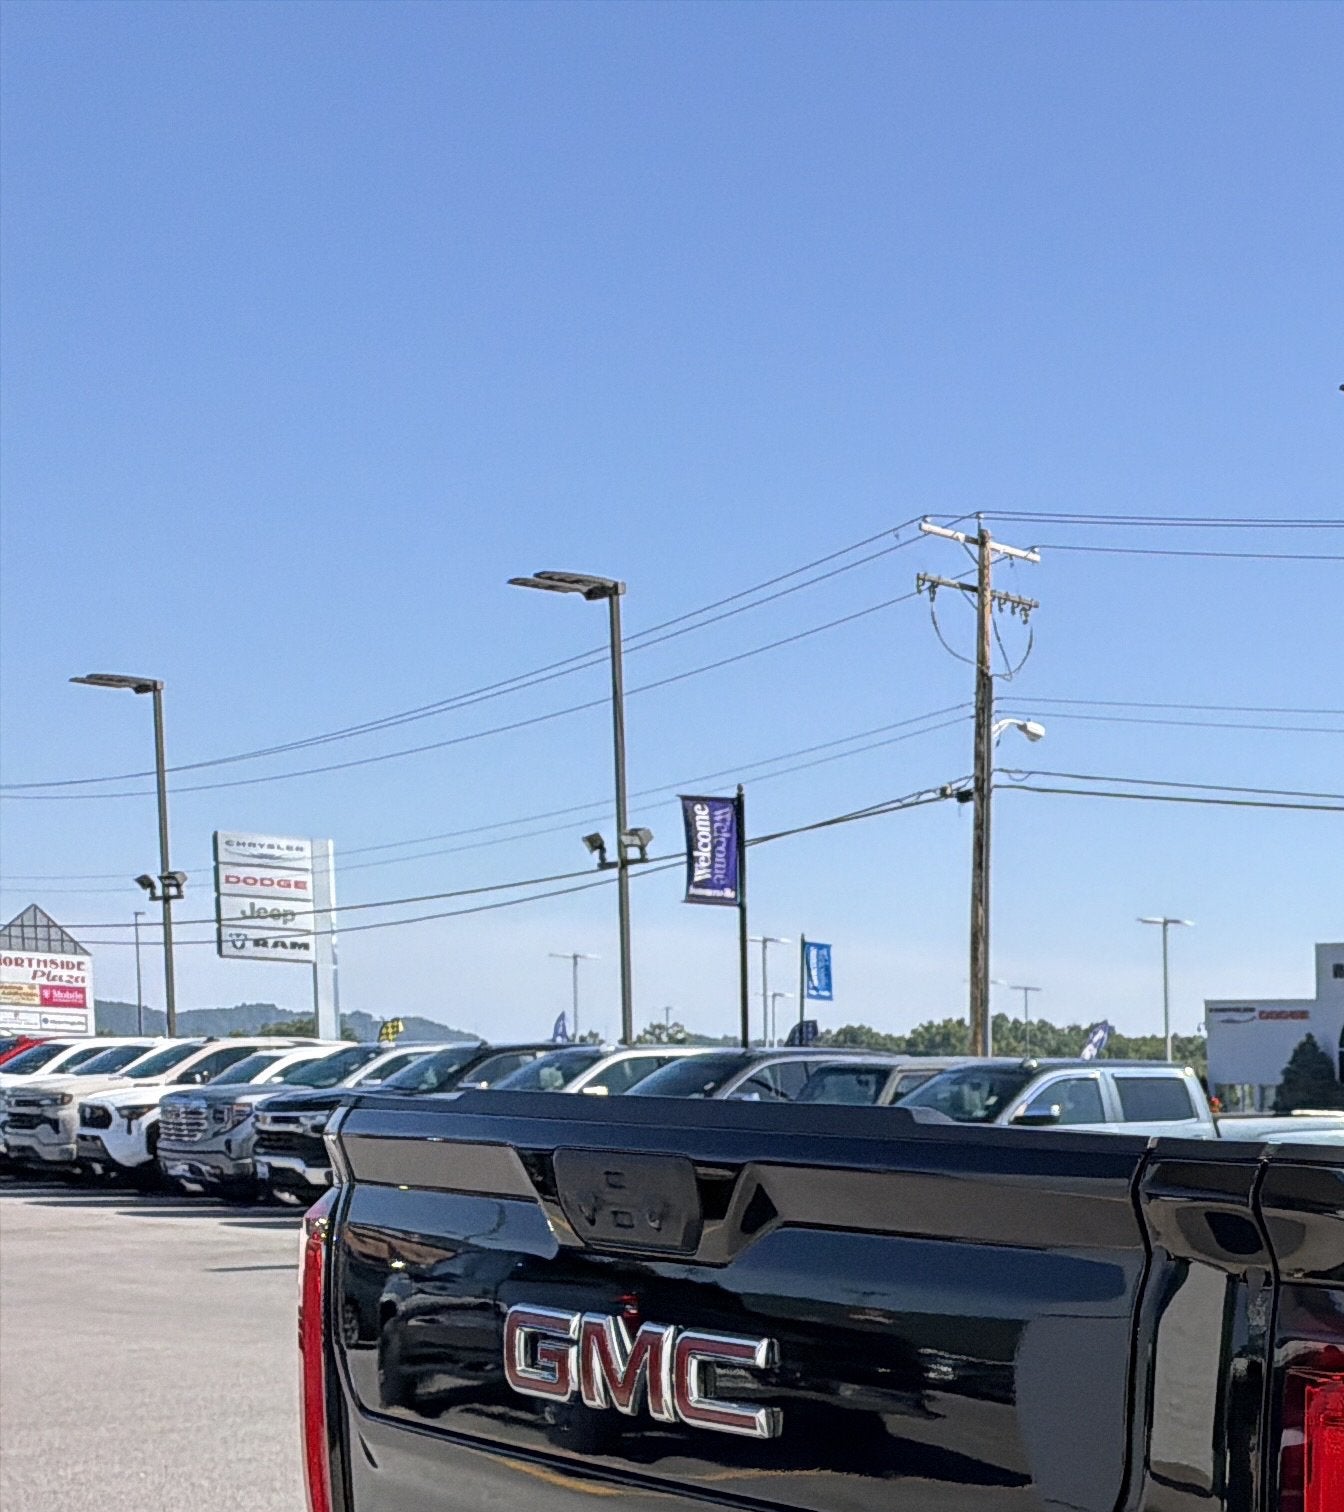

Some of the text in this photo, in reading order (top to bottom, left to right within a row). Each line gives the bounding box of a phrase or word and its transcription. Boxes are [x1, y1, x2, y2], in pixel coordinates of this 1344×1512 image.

[692, 803, 712, 882] Welcome
[224, 874, 308, 890] DODGE
[241, 901, 296, 925] Jeep
[253, 938, 310, 951] RAM
[0, 954, 86, 972] ORTHSIDE
[31, 969, 86, 984] Plaza
[503, 1302, 784, 1440] GMC
